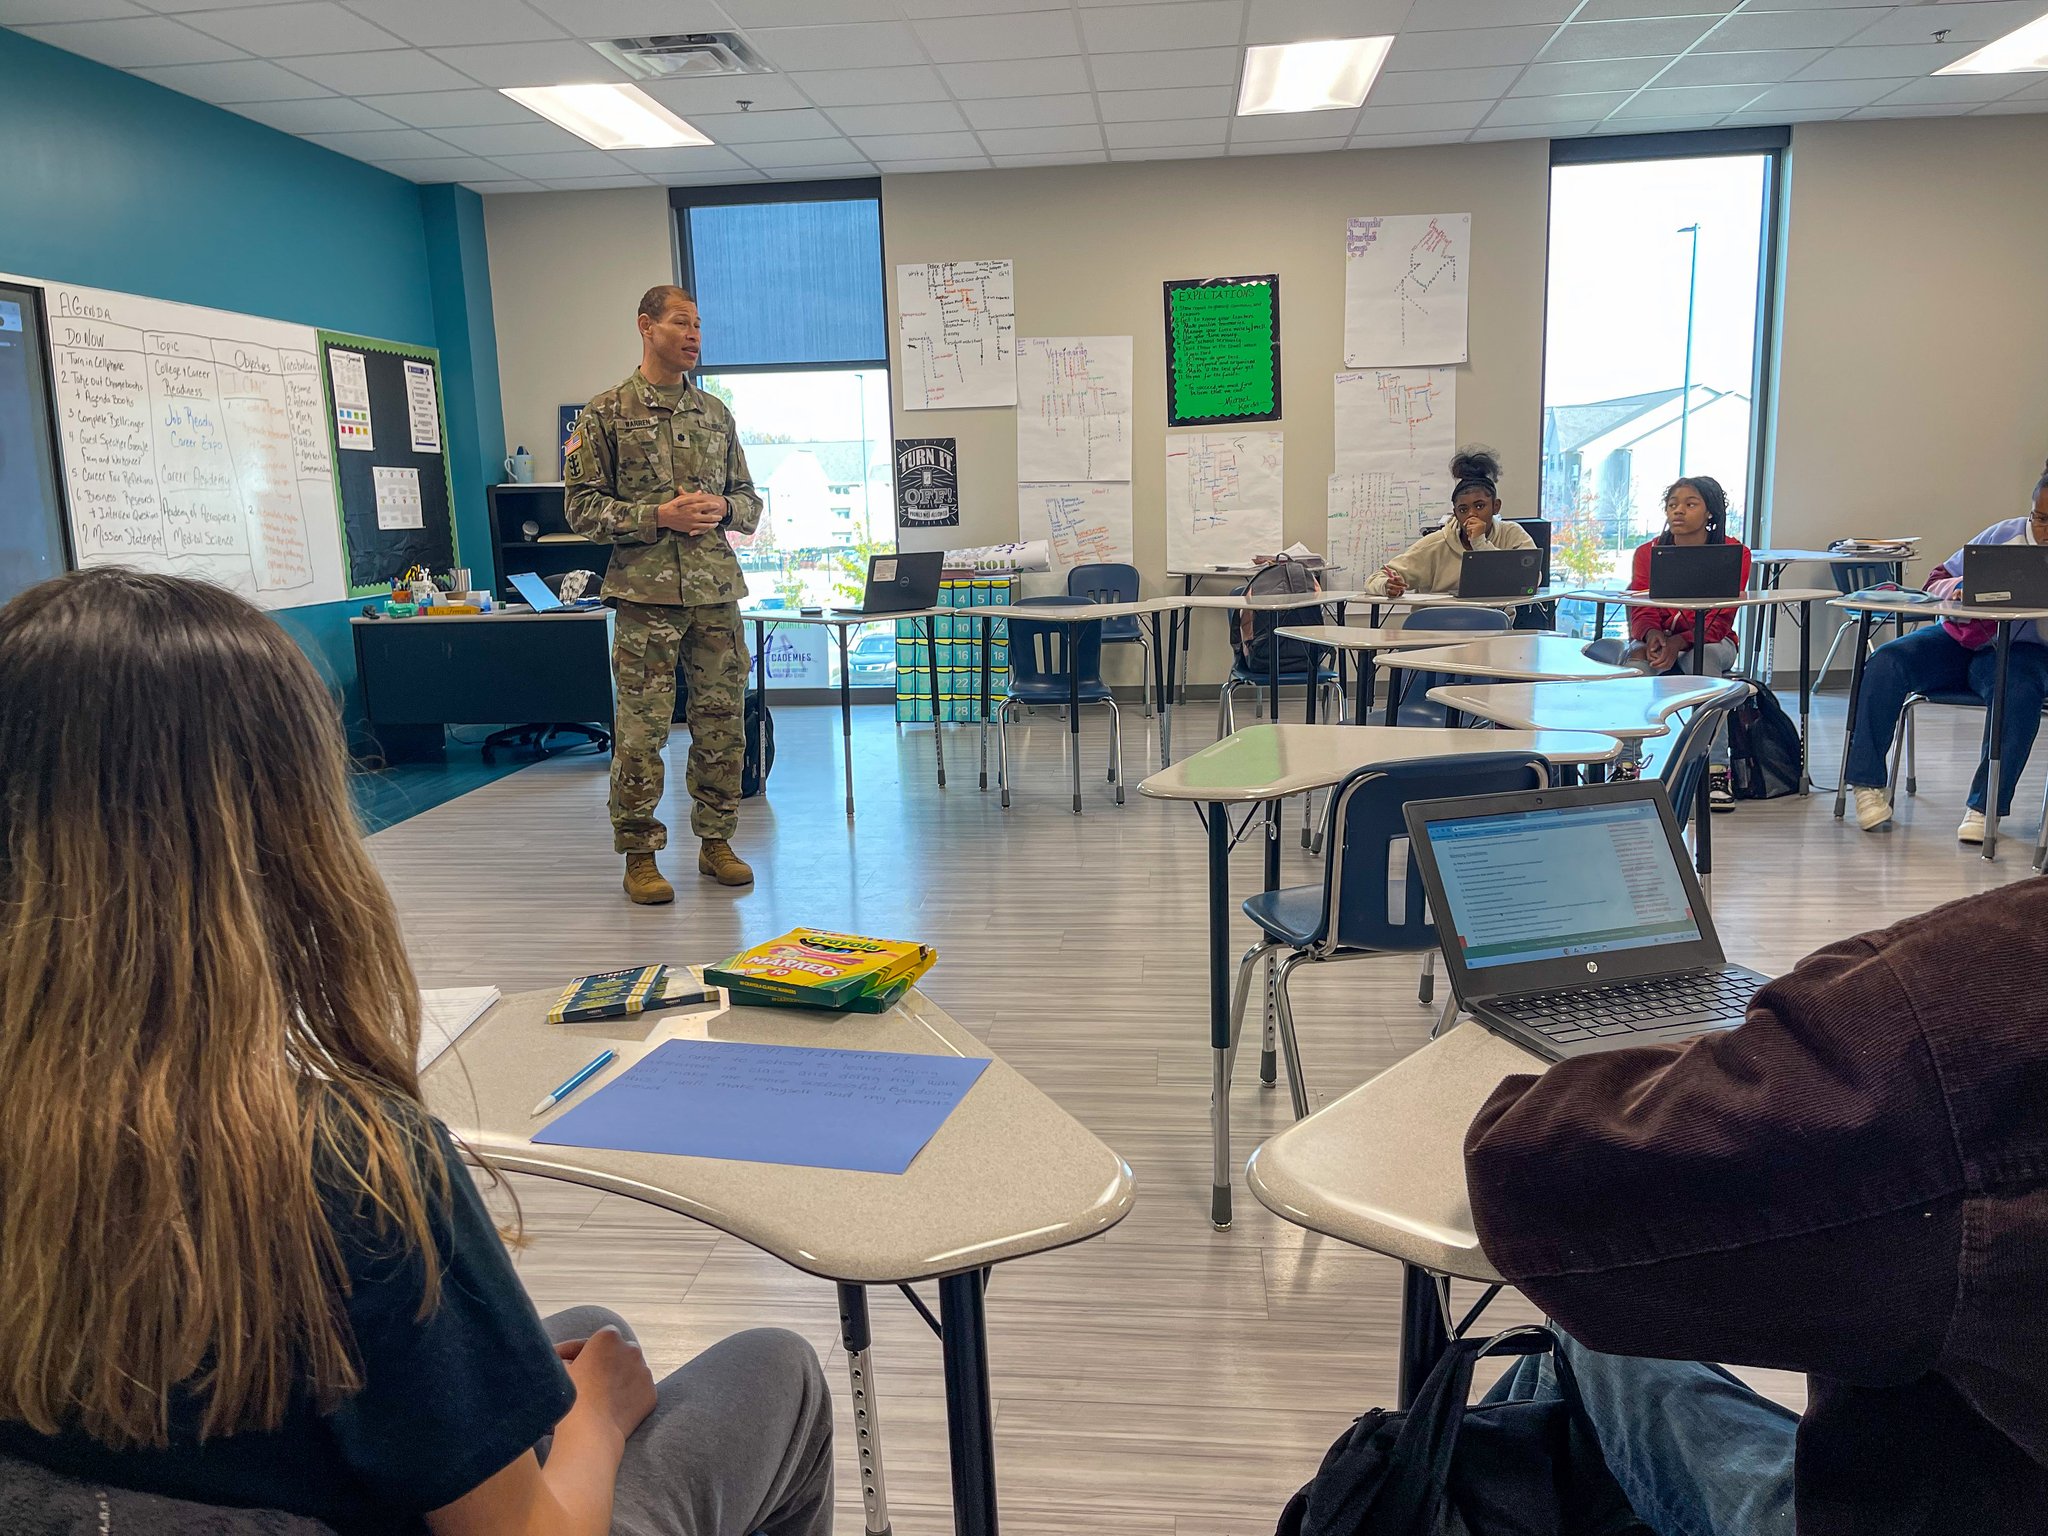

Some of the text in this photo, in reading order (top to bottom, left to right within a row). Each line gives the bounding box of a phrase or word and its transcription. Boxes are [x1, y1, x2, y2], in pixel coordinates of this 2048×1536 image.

[1179, 289, 1255, 302] EXPECTATIONS
[67, 352, 84, 366] Turn
[155, 359, 210, 380] College Career
[71, 371, 89, 388] Take
[91, 378, 103, 387] out
[85, 390, 111, 407] Agenda
[112, 394, 135, 407] Books
[78, 408, 107, 429] Complete
[165, 404, 182, 426] Job
[184, 406, 214, 436] Ready
[624, 420, 650, 428] WARREN
[80, 429, 98, 445] Guest
[171, 431, 222, 455] Career Expo
[99, 455, 110, 464] and
[900, 448, 953, 473] TURN IT
[82, 467, 105, 481] Career
[161, 464, 186, 484] Career
[122, 490, 155, 510] Research
[905, 488, 953, 505] OFF!
[92, 524, 123, 548] Mission
[124, 526, 162, 550] Statement
[174, 527, 234, 549] Medical Science
[940, 594, 1003, 604] 3 4 5 6
[941, 622, 948, 632] 9
[957, 623, 969, 632] 10
[957, 650, 968, 660] 16
[994, 651, 1005, 661] 18
[956, 678, 1005, 688] 22 2 24
[955, 706, 968, 716] 28
[974, 706, 981, 716] 2
[807, 936, 881, 951] Crayola
[745, 956, 844, 978] MARKERS
[756, 1057, 803, 1066] school
[793, 1049, 912, 1063] Statement
[749, 1066, 785, 1074] class
[798, 1070, 828, 1078] and
[838, 1073, 880, 1082] doing
[890, 1077, 915, 1086] my
[716, 1082, 753, 1090] make
[765, 1086, 811, 1097] myself
[824, 1090, 854, 1098] and
[864, 1094, 887, 1104] my
[896, 1098, 951, 1107] parents
[754, 1076, 790, 1084] more
[888, 1086, 908, 1095] By
[915, 1088, 954, 1098] doing
